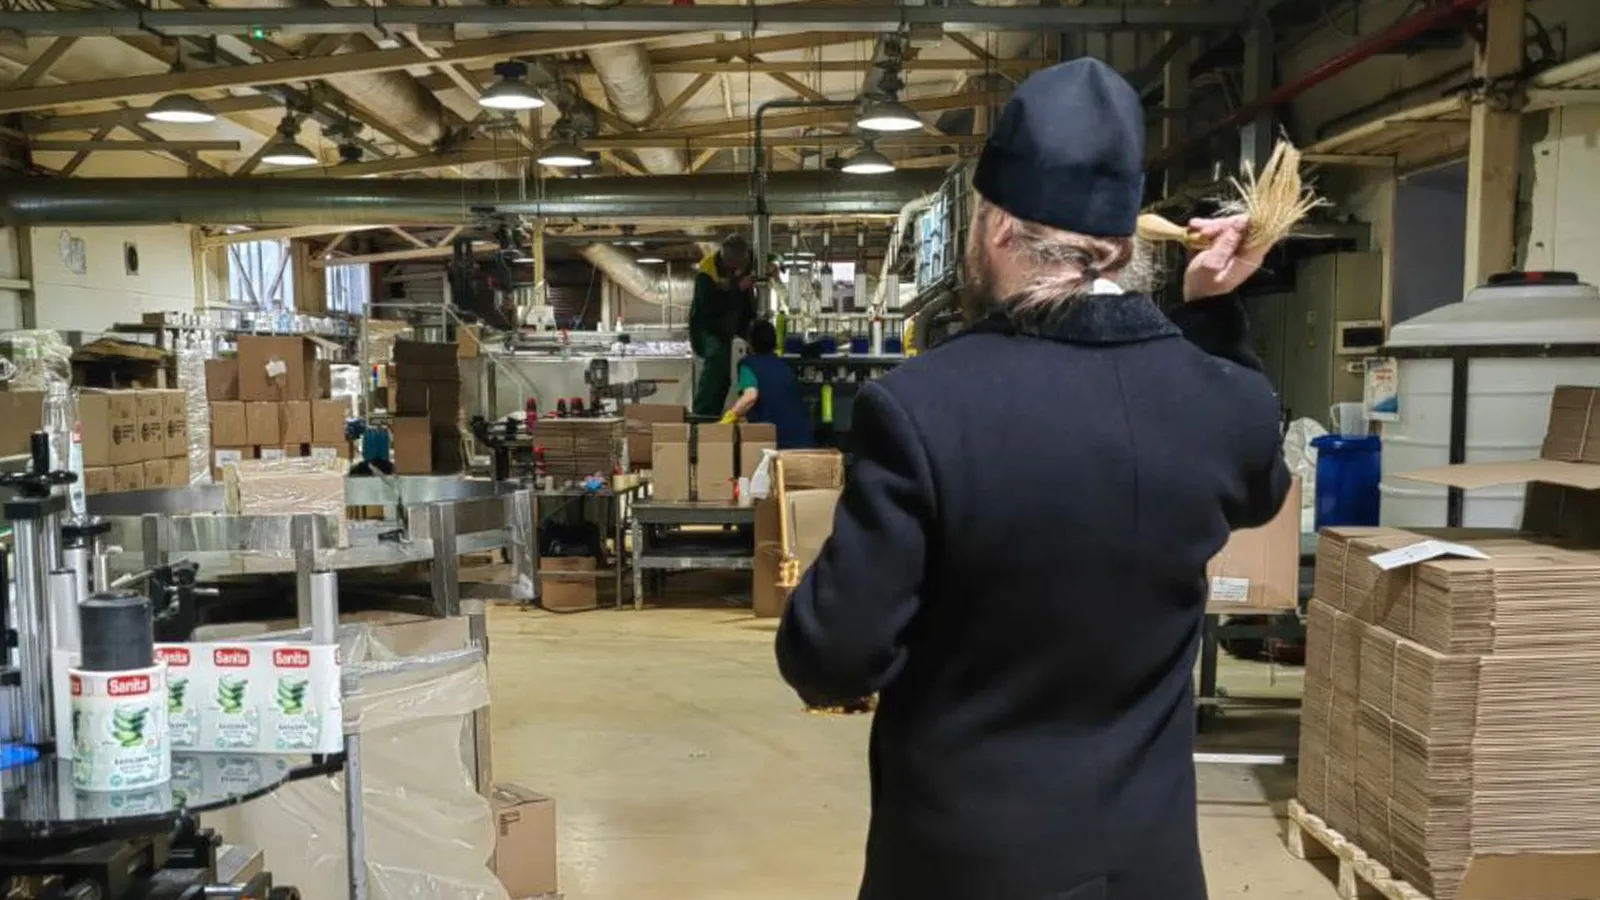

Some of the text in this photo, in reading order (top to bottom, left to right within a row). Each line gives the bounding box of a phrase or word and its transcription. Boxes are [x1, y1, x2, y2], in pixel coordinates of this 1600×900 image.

[215, 650, 248, 665] Sanita
[275, 651, 308, 665] Sanita
[109, 677, 149, 694] Sanita
